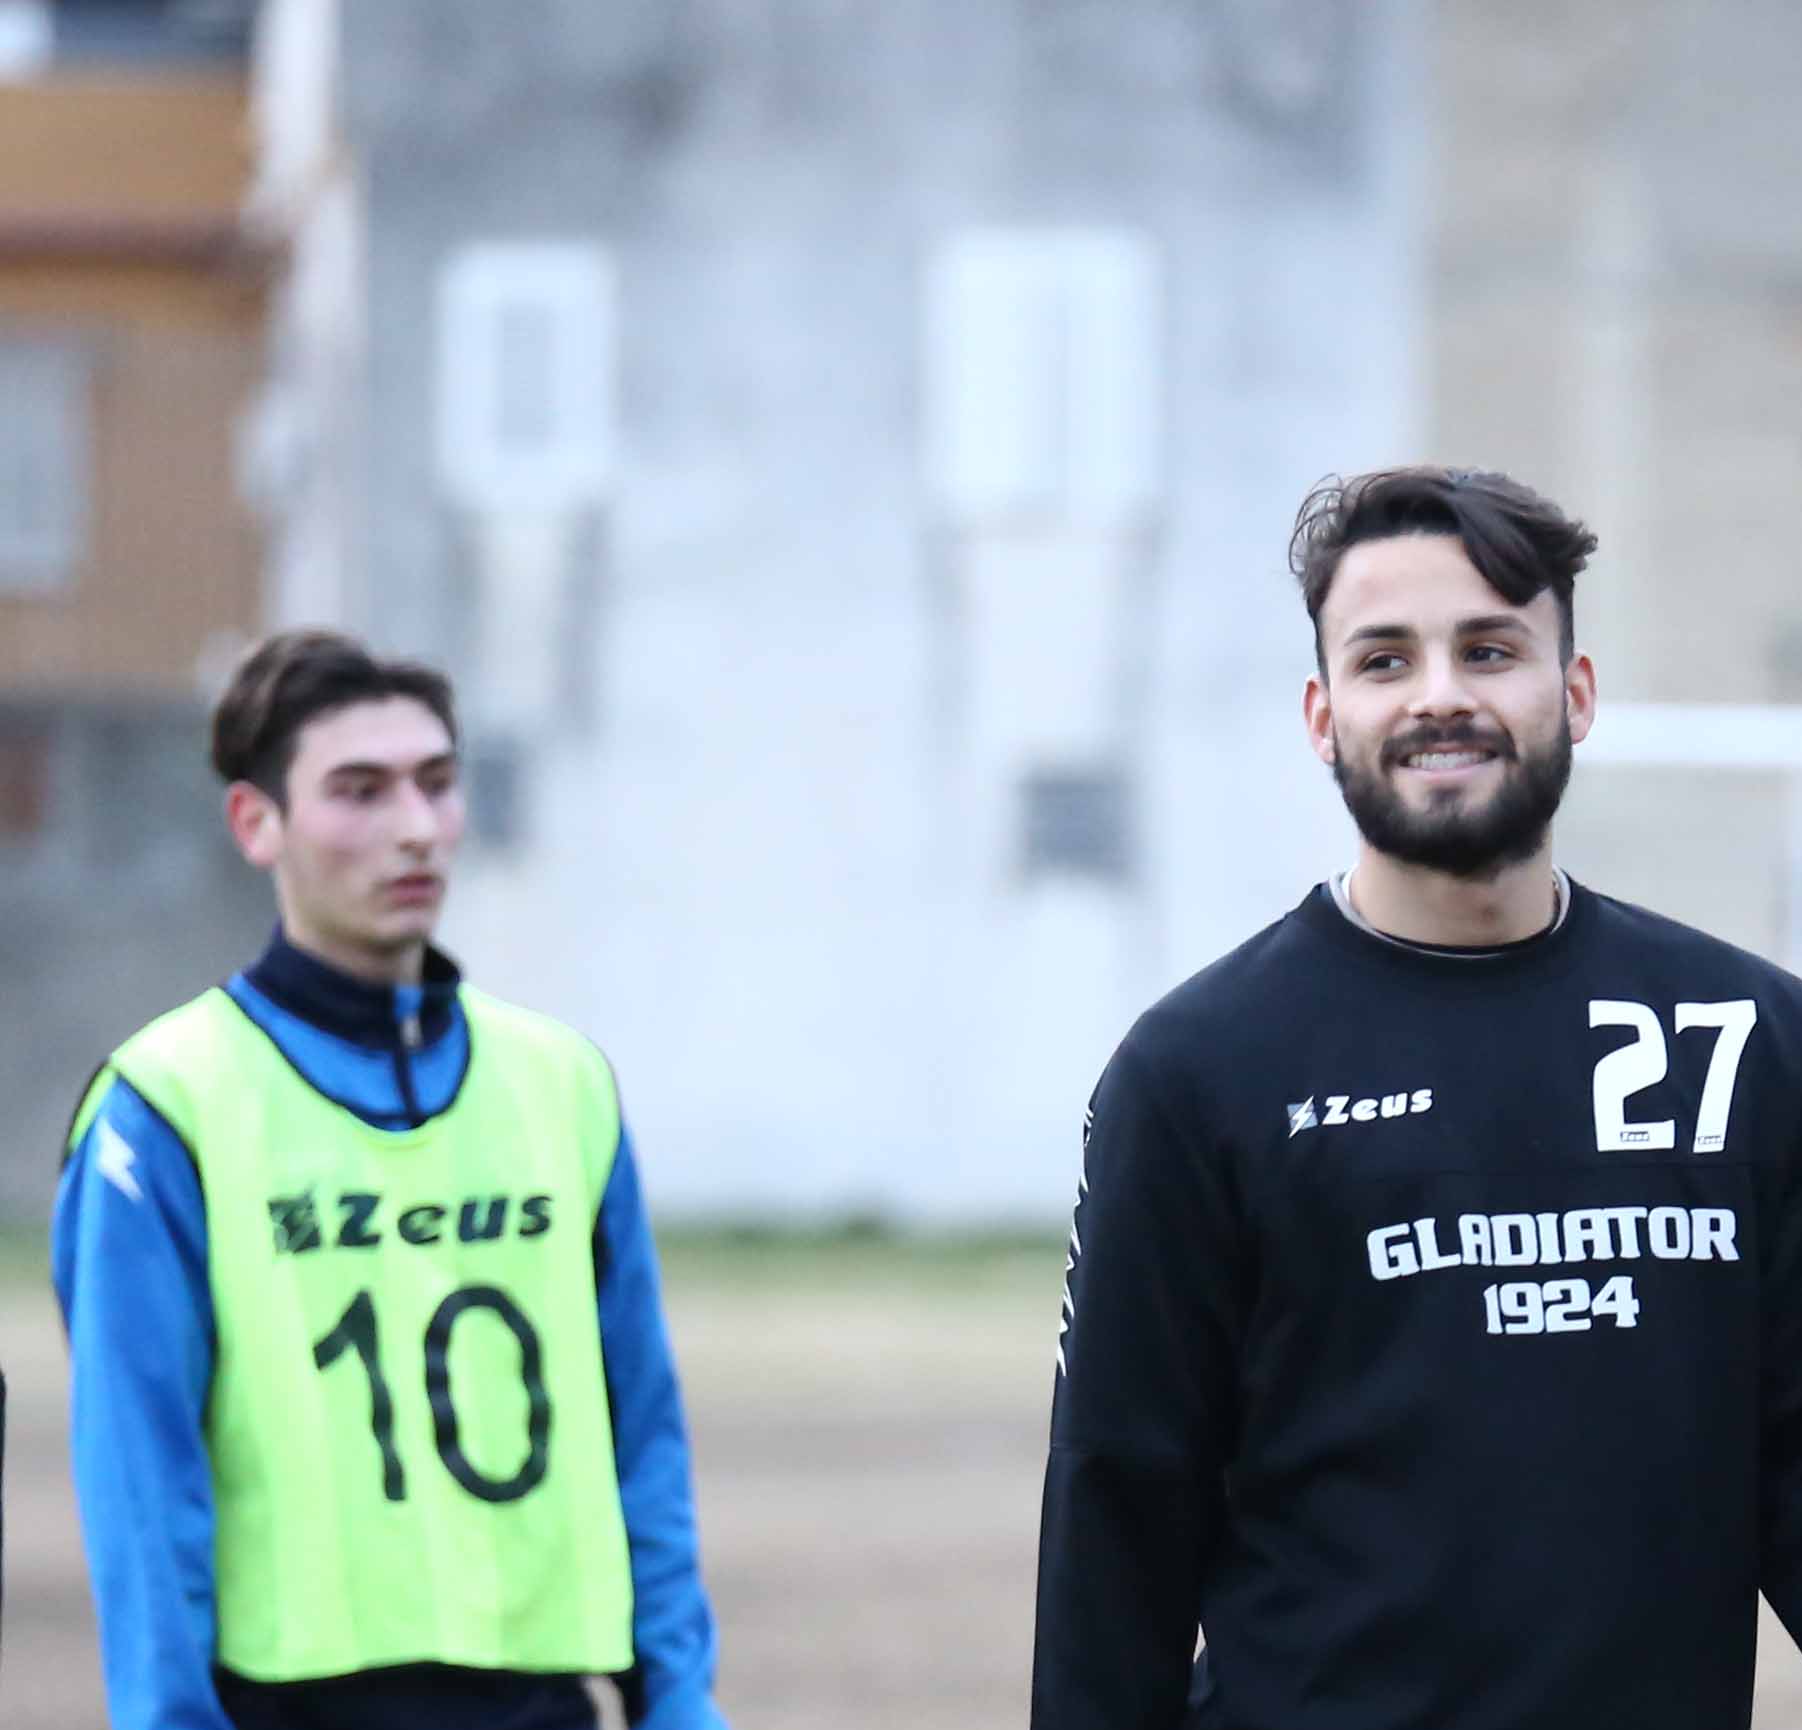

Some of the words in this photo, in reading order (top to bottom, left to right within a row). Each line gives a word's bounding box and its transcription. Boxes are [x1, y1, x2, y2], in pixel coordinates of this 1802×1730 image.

[1321, 1088, 1433, 1126] Zeus
[1588, 999, 1757, 1153] 27
[336, 1193, 554, 1247] Zeus
[1366, 1206, 1740, 1281] GLADIATOR
[1483, 1275, 1640, 1334] 1924
[312, 1284, 552, 1504] 10
